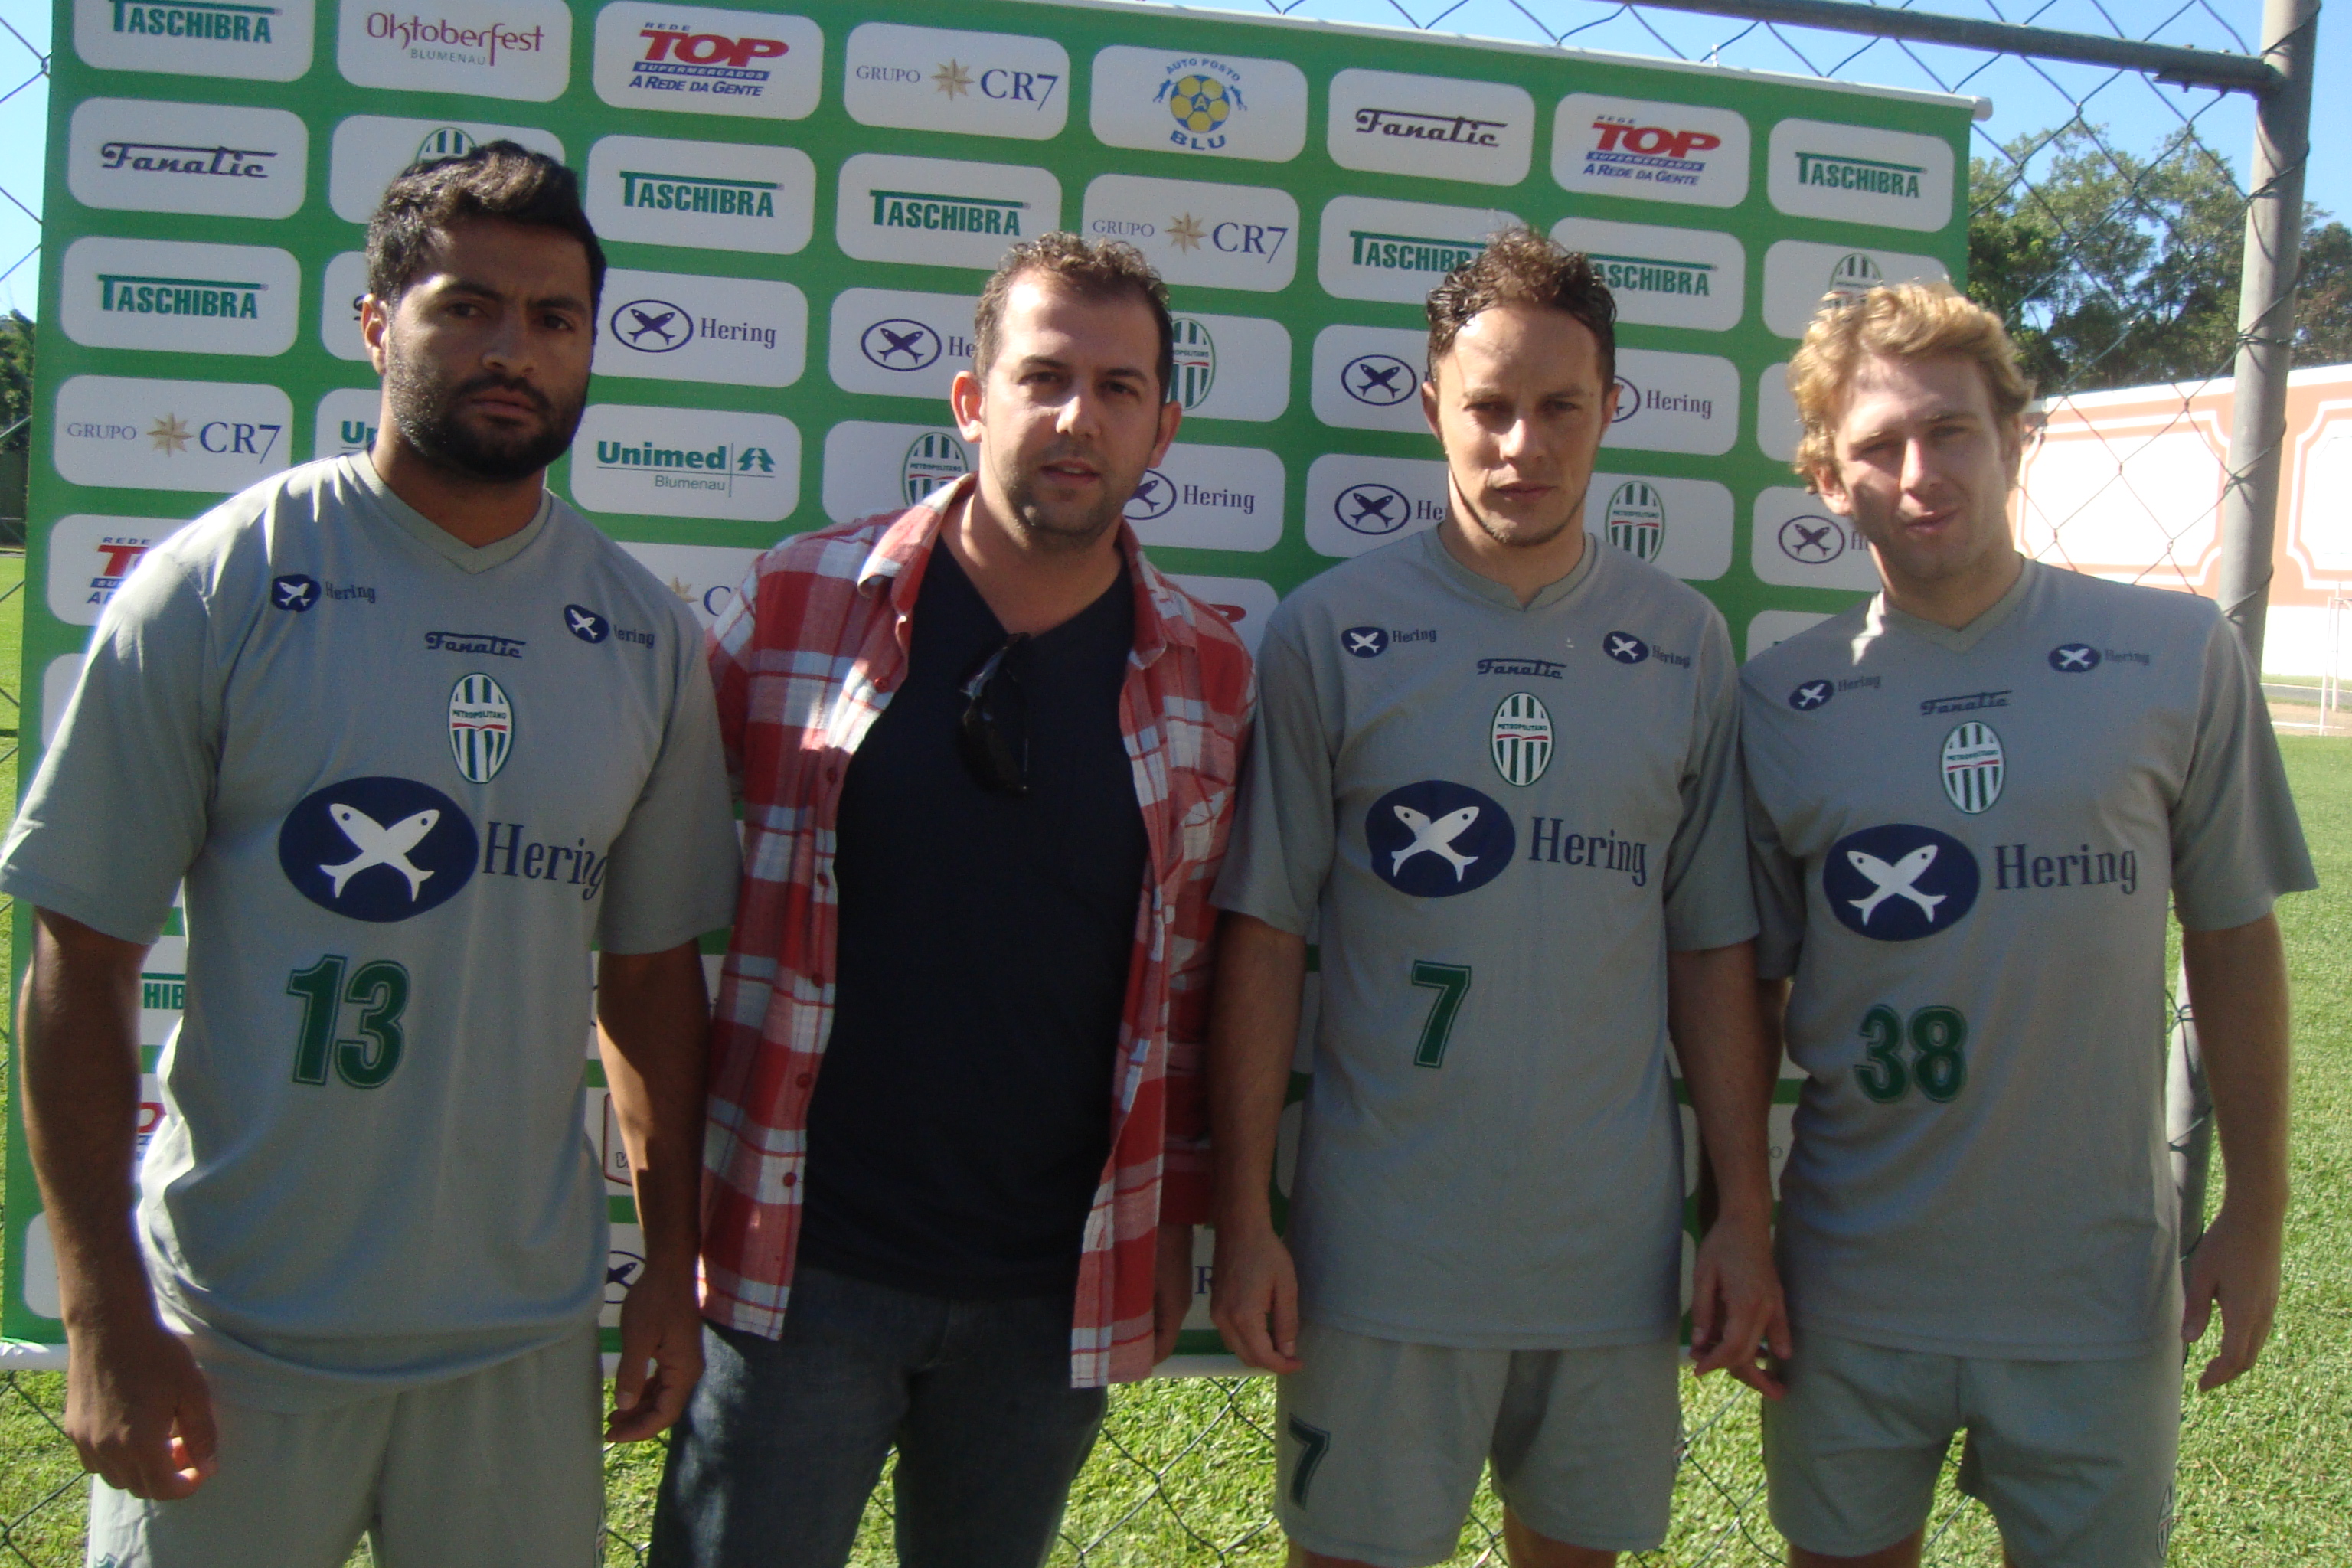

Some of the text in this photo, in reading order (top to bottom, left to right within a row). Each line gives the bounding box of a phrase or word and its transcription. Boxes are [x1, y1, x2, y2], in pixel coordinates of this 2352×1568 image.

[109, 0, 278, 44] TASCHIBRA
[368, 12, 544, 66] Oktoberfest
[645, 22, 691, 31] REDE
[410, 48, 485, 66] BLUMENAU
[639, 29, 789, 67] TOP
[629, 75, 642, 88] A
[689, 80, 708, 93] DA
[1166, 58, 1197, 75] AUTO
[856, 65, 1059, 112] GRUPO CR7
[1170, 129, 1226, 151] BLU
[1355, 109, 1508, 148] Fanatic
[1592, 122, 1721, 158] TOP
[101, 142, 278, 178] Fanatic
[1583, 163, 1595, 175] A
[1795, 152, 1924, 198] TASCHIBRA
[619, 171, 778, 218] TASCHIBRA
[869, 189, 1024, 237] TASCHIBRA
[1093, 219, 1289, 264] GRUPO CR7
[97, 274, 262, 319] TASCHIBRA
[701, 317, 777, 350] Hering
[1646, 389, 1713, 420] Hering
[67, 421, 282, 464] GRUPO CR7
[596, 440, 727, 470] Unimed
[655, 475, 725, 491] Blumenau
[1183, 484, 1255, 514] Hering
[102, 537, 152, 545] REDE
[325, 581, 376, 604] Hering
[425, 632, 527, 658] Fanatic
[1392, 628, 1436, 643] Hering
[1477, 658, 1566, 680] Fanatic
[1920, 690, 2014, 716] Fanatic
[1530, 816, 1647, 887] Hering
[1994, 843, 2138, 895] Hering
[286, 953, 410, 1090] 13
[1410, 959, 1472, 1069] 7
[1852, 1002, 1969, 1104] 38
[1289, 1413, 1331, 1511] 7
